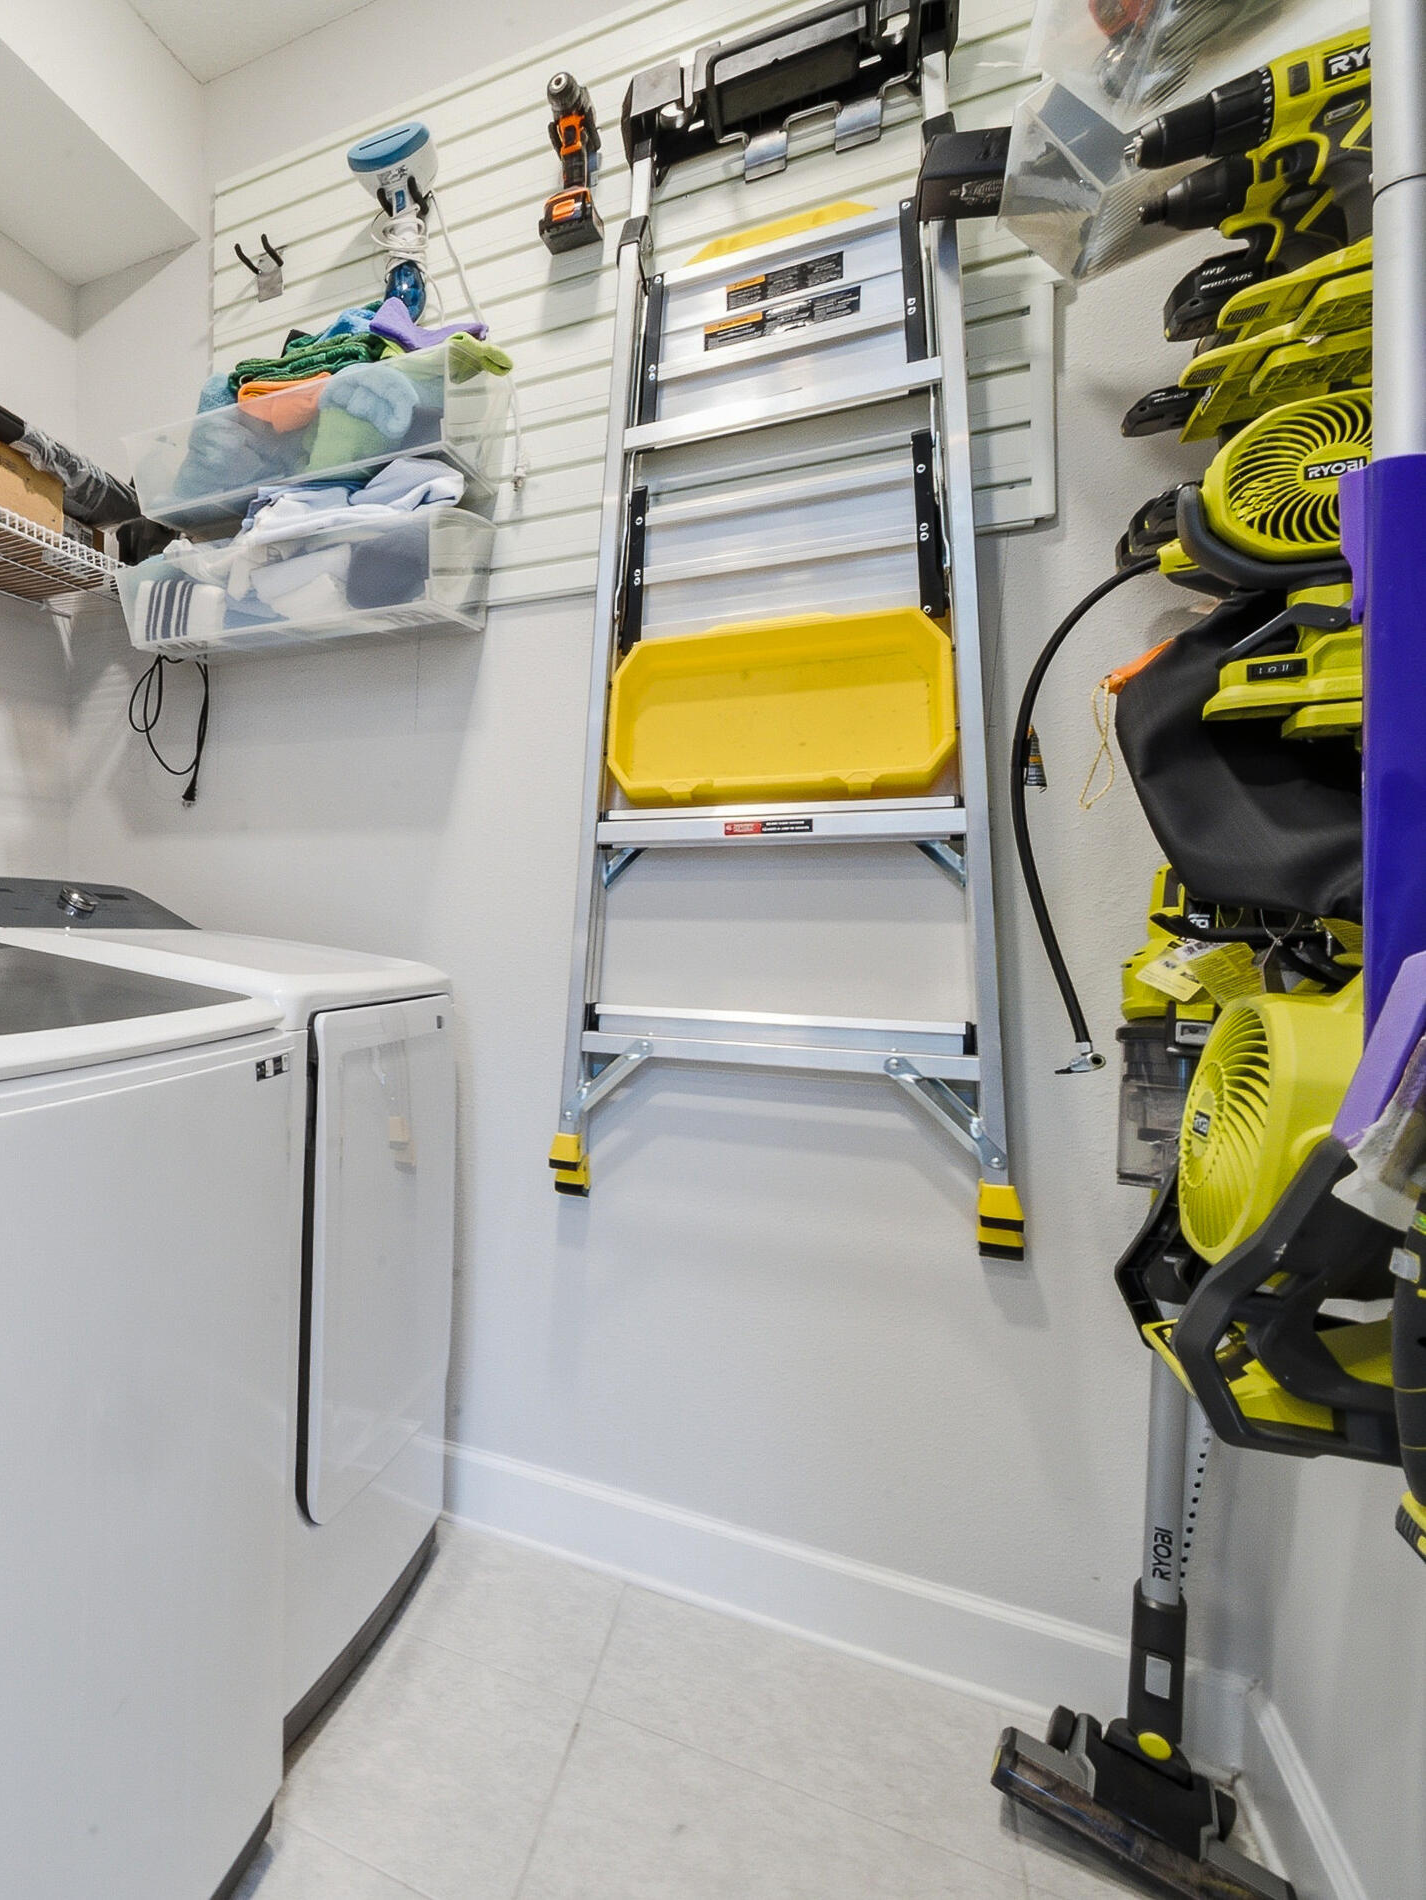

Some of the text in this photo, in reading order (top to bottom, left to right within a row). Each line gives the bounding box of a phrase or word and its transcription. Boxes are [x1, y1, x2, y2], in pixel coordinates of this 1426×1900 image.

[1328, 46, 1373, 76] RY
[1307, 458, 1365, 479] RYOBI
[1152, 1526, 1174, 1582] RYOBI
